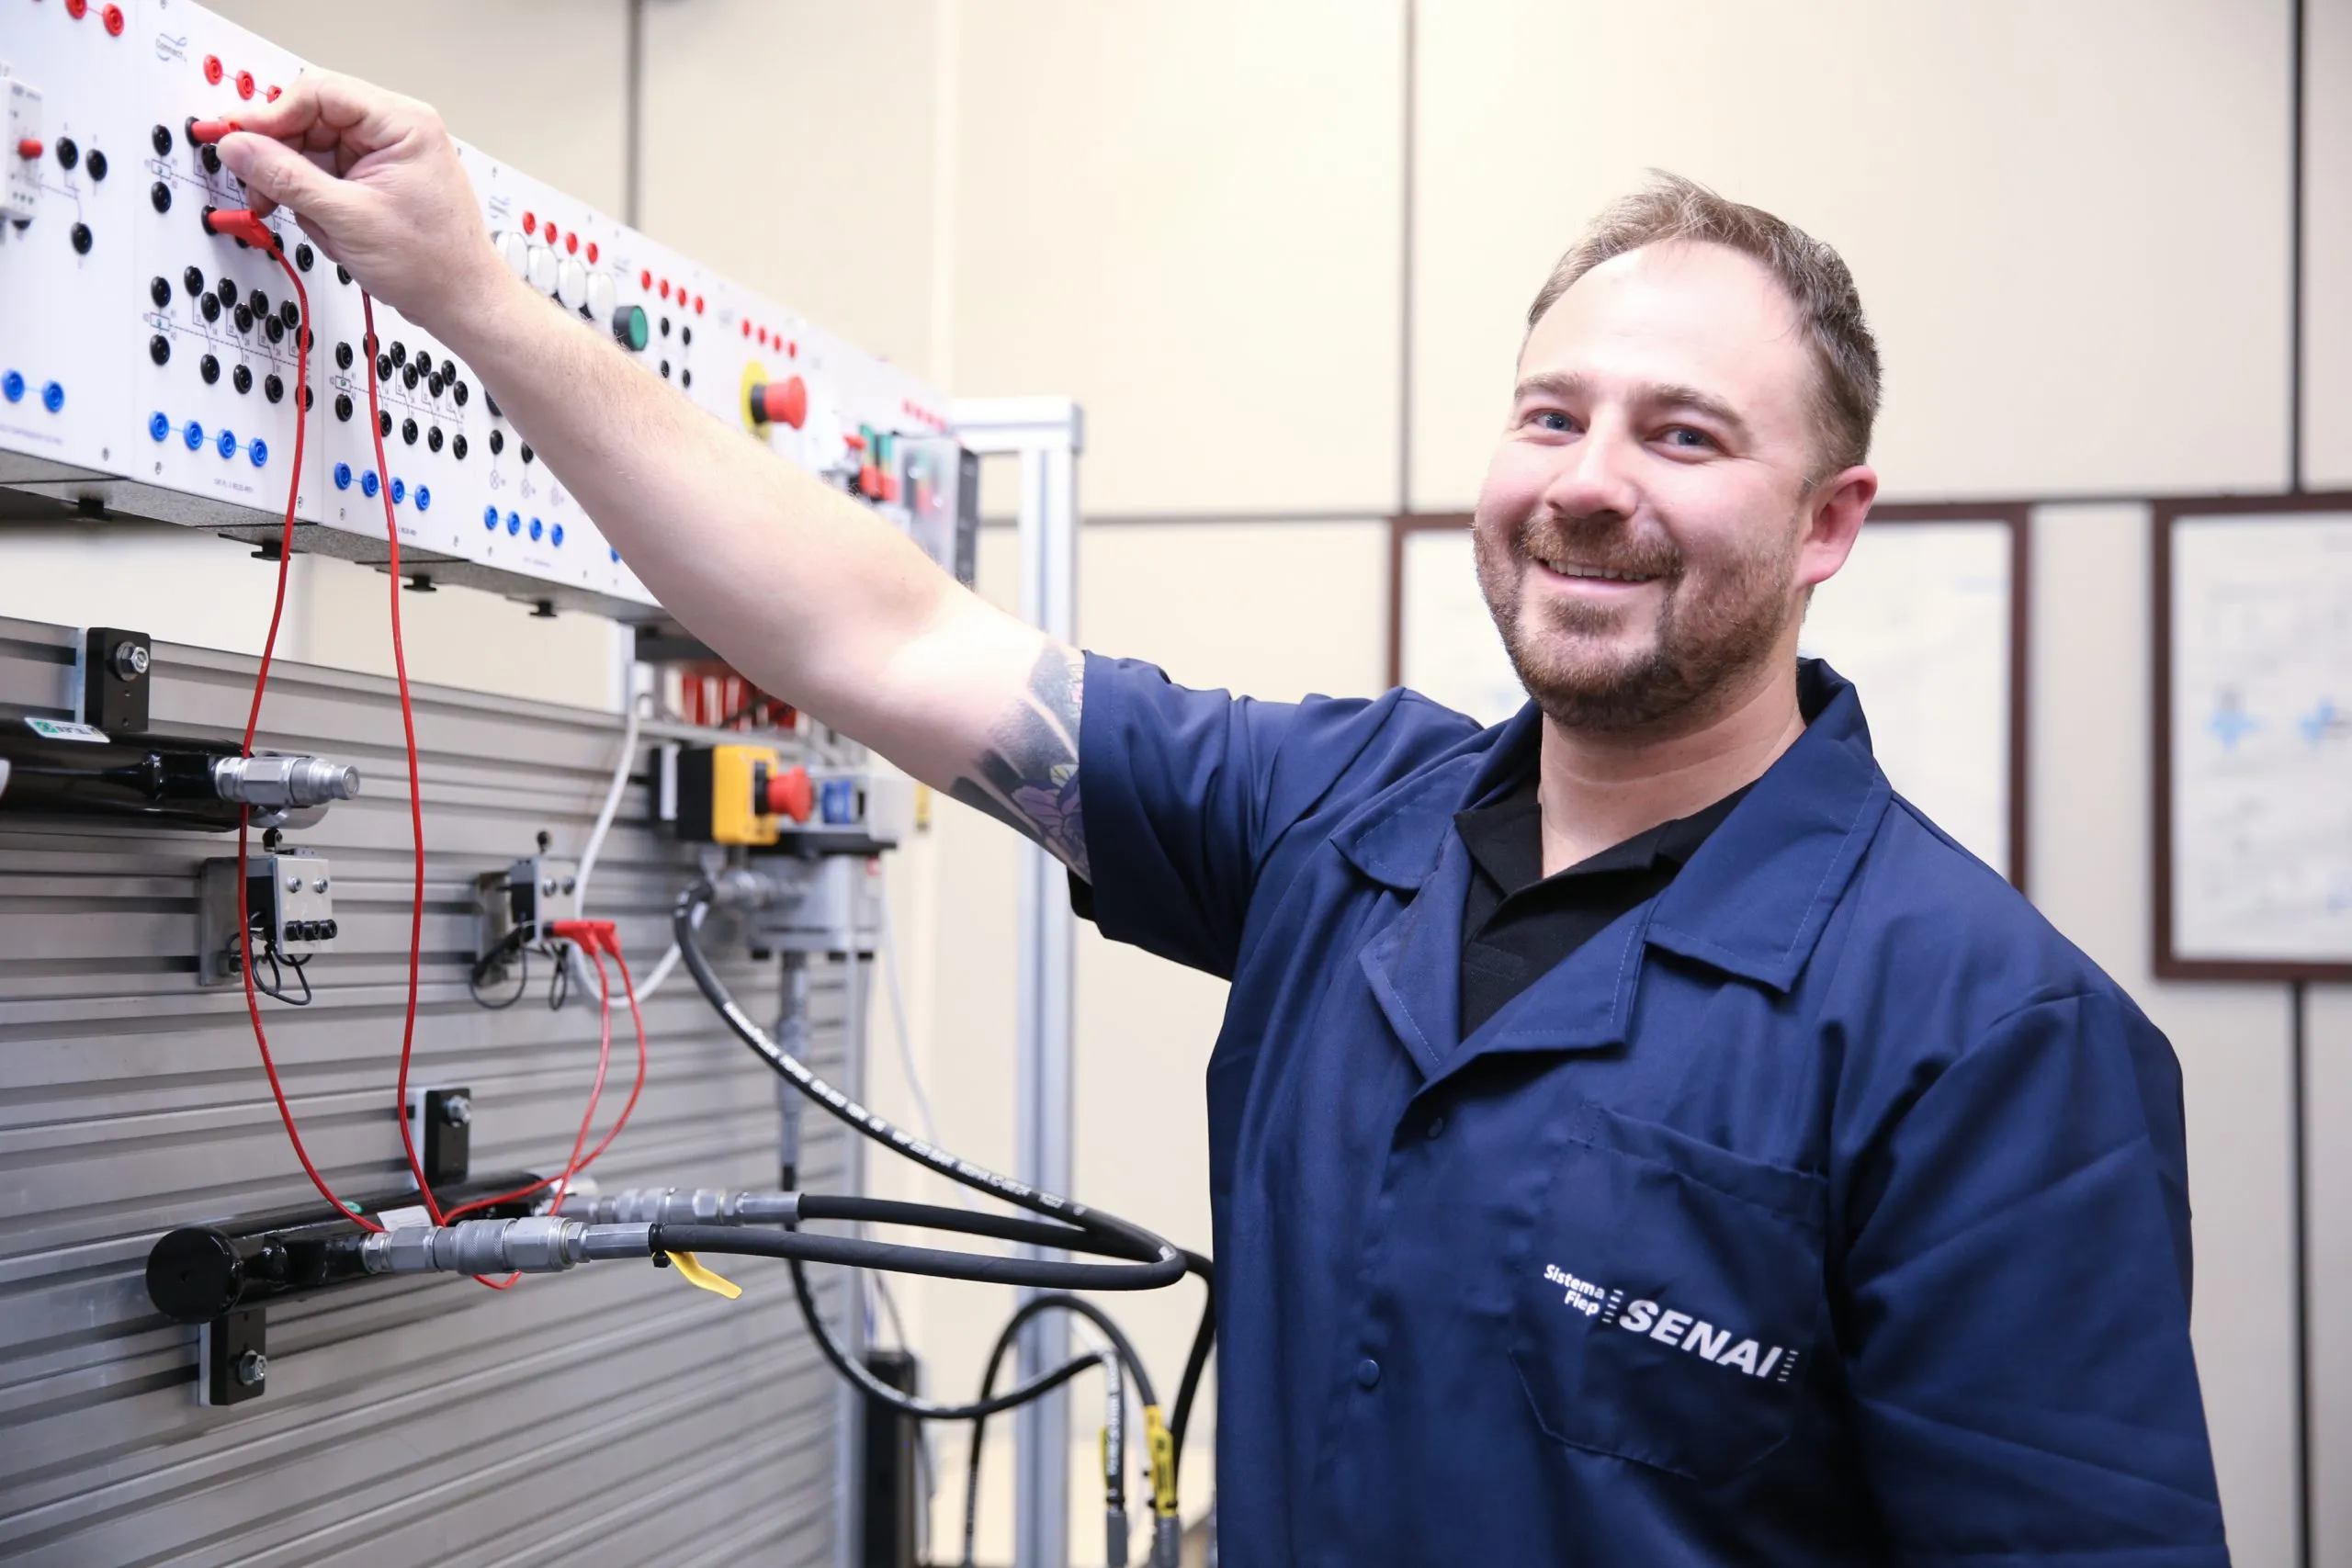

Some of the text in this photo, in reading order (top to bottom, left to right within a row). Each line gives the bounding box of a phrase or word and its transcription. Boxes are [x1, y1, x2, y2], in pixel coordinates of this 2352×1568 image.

[155, 38, 183, 60] Connect
[1544, 1264, 1605, 1300] Sistema
[1564, 1290, 1600, 1315] Fiep
[1619, 1299, 1782, 1378] SENAI
